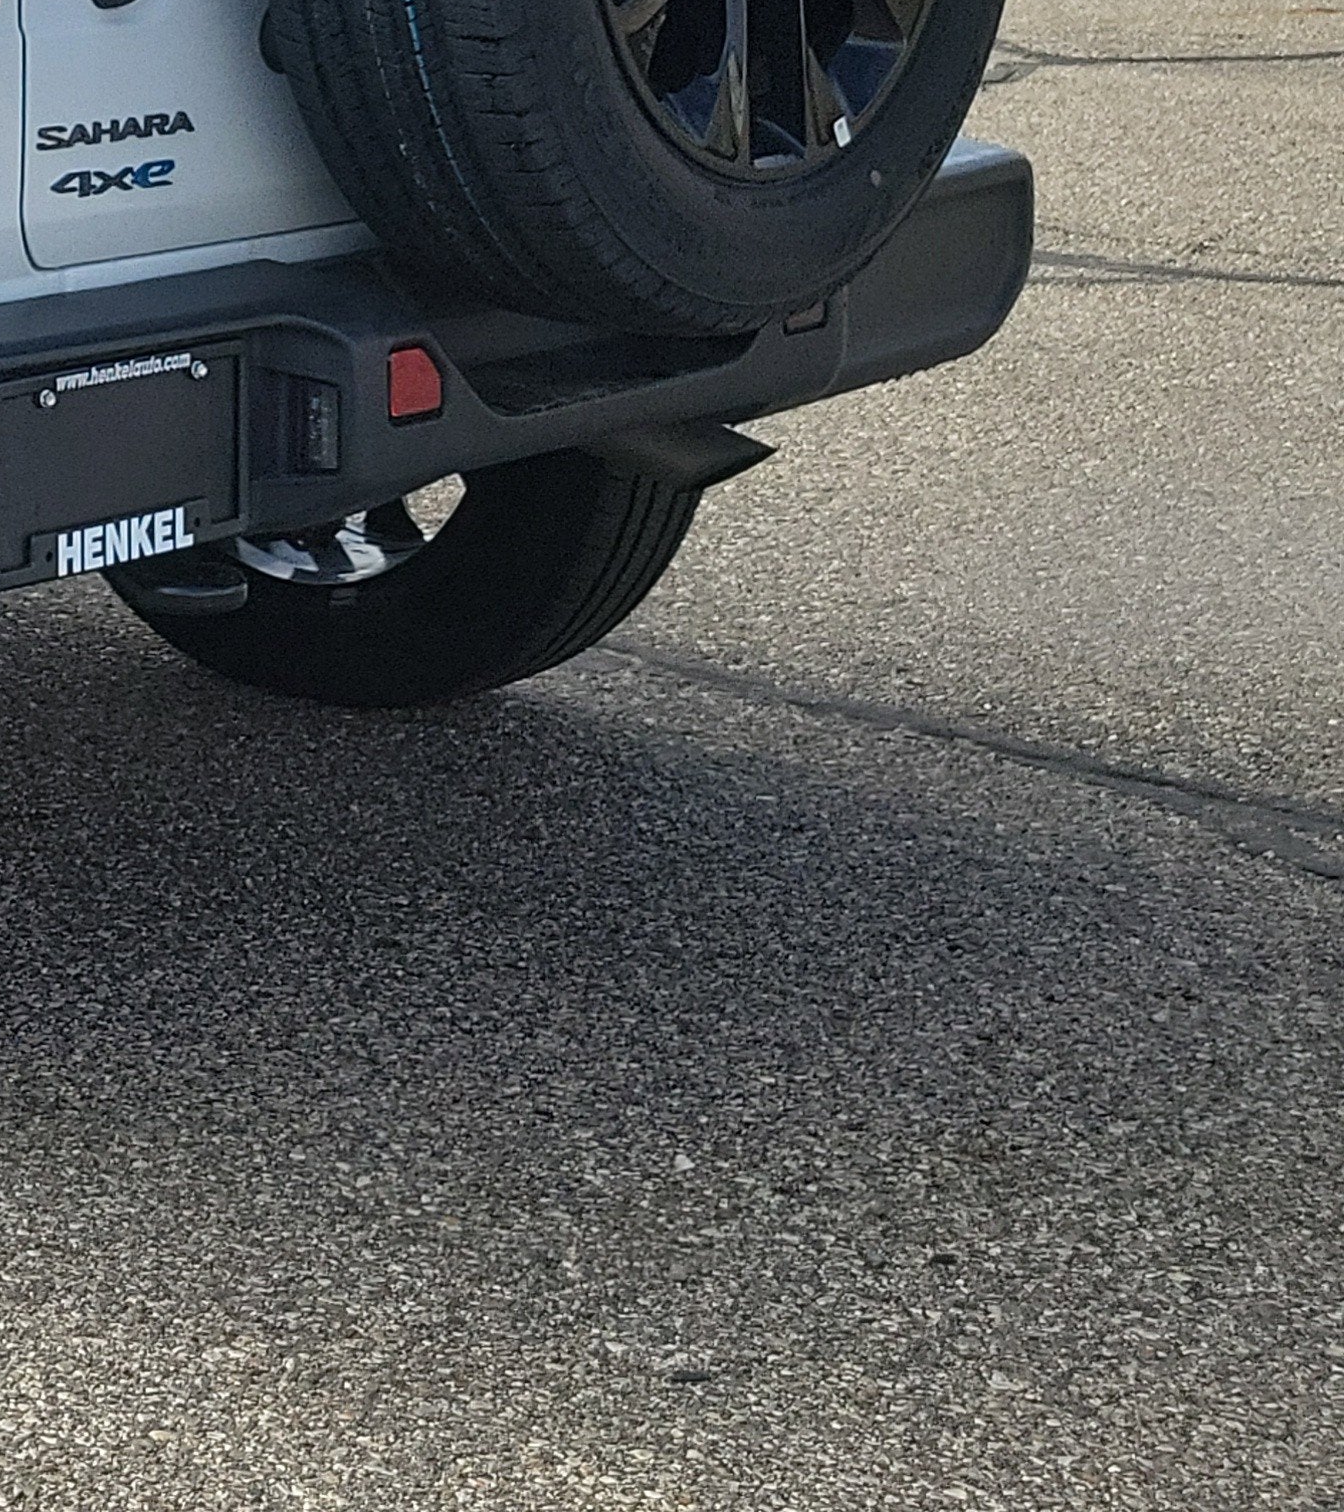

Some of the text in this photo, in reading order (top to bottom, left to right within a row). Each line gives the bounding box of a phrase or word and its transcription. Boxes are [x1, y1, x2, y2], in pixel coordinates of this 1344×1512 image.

[36, 110, 195, 152] SAHARA
[55, 352, 191, 393] www.henkelauto.com
[57, 506, 194, 578] HENKEL
